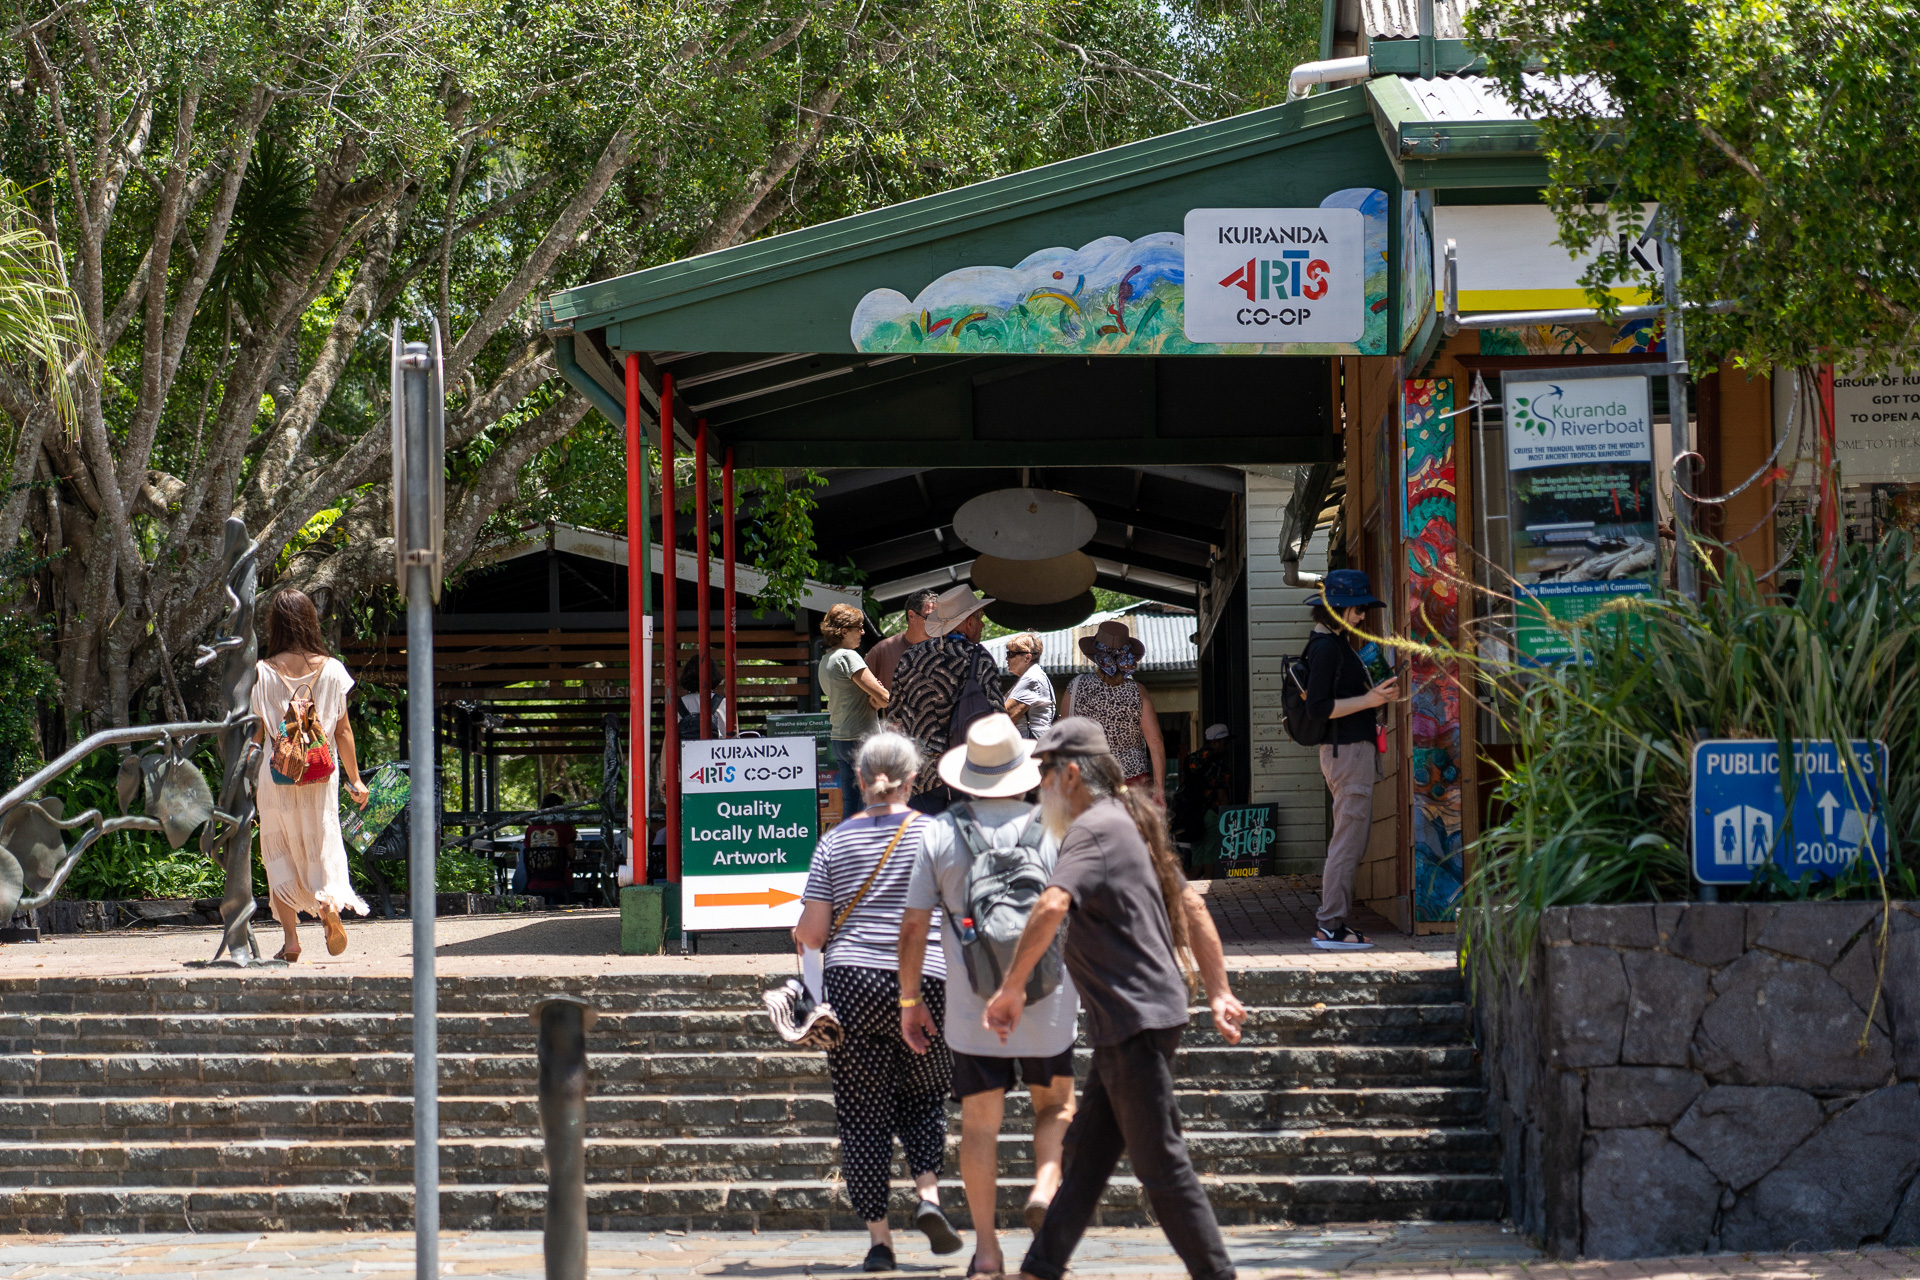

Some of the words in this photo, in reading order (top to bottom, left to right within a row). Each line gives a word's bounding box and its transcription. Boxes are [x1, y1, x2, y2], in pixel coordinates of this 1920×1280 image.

[1218, 226, 1329, 244] KURANDA
[1218, 250, 1331, 303] ARTS
[1236, 308, 1311, 326] CO-OP
[1833, 377, 1878, 388] GROUP
[1881, 377, 1899, 386] OF
[1872, 395, 1900, 404] GOT
[1552, 401, 1627, 418] Kuranda
[1850, 413, 1868, 423] TO
[1871, 412, 1908, 422] OPEN
[1561, 418, 1644, 436] Riverboat
[1546, 445, 1575, 453] TRANQUIL
[1619, 441, 1645, 449] WORLD'S
[1865, 439, 1883, 449] TO
[1886, 439, 1912, 448] THE
[1540, 582, 1571, 595] Riverboat
[1573, 584, 1593, 593] Cruise
[1594, 583, 1609, 592] with
[1610, 582, 1651, 593] Commentary
[711, 745, 790, 760] KURANDA
[1706, 753, 1780, 775] PUBLIC
[689, 762, 736, 785] ARTS
[744, 766, 804, 781] CO-OP
[717, 800, 782, 819] Quality
[1218, 808, 1270, 836] GIFT
[691, 825, 752, 844] Locally
[758, 822, 809, 840] Made
[1218, 828, 1276, 860] SHOP
[713, 848, 787, 866] Artwork
[1796, 842, 1860, 865] 200m
[1228, 867, 1259, 877] UNIQUE
